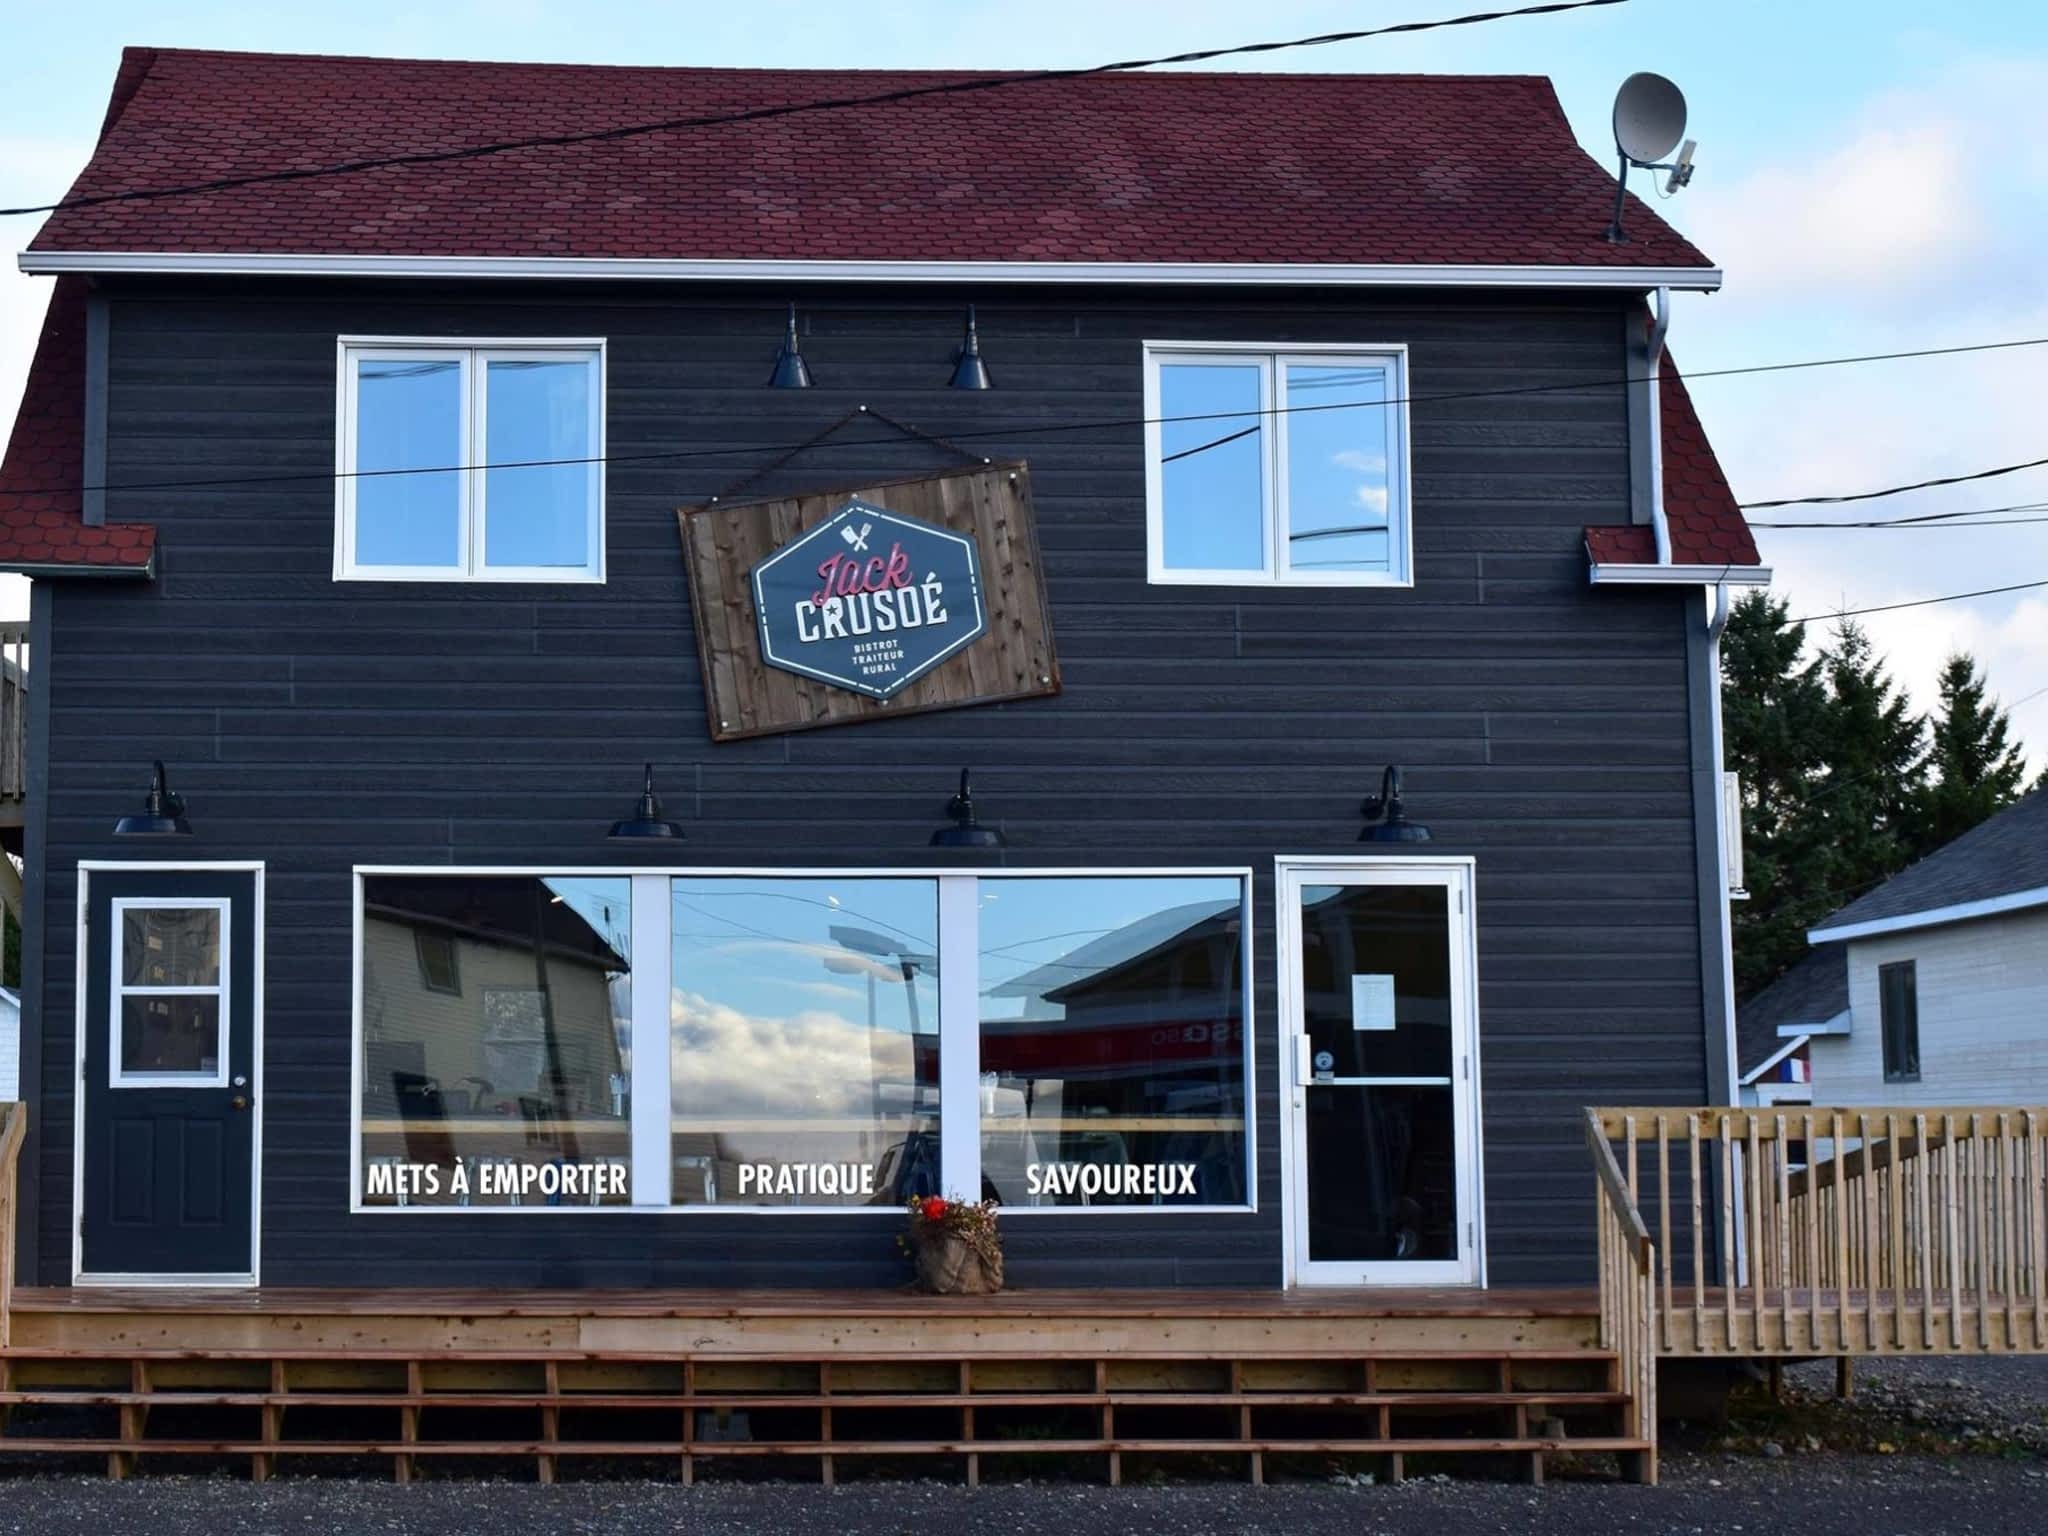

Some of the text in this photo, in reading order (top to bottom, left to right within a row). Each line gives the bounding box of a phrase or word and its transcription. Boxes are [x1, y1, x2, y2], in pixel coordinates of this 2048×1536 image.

[811, 543, 912, 606] Jack
[795, 571, 948, 642] CRUSOÉ
[852, 650, 904, 665] TRAITEUR
[853, 639, 898, 654] BISTROT
[862, 662, 896, 675] RURAL
[367, 1156, 627, 1195] METS À EMPORTER
[738, 1163, 874, 1195] PRATIQUE
[1026, 1163, 1197, 1195] SAVOUREUX
